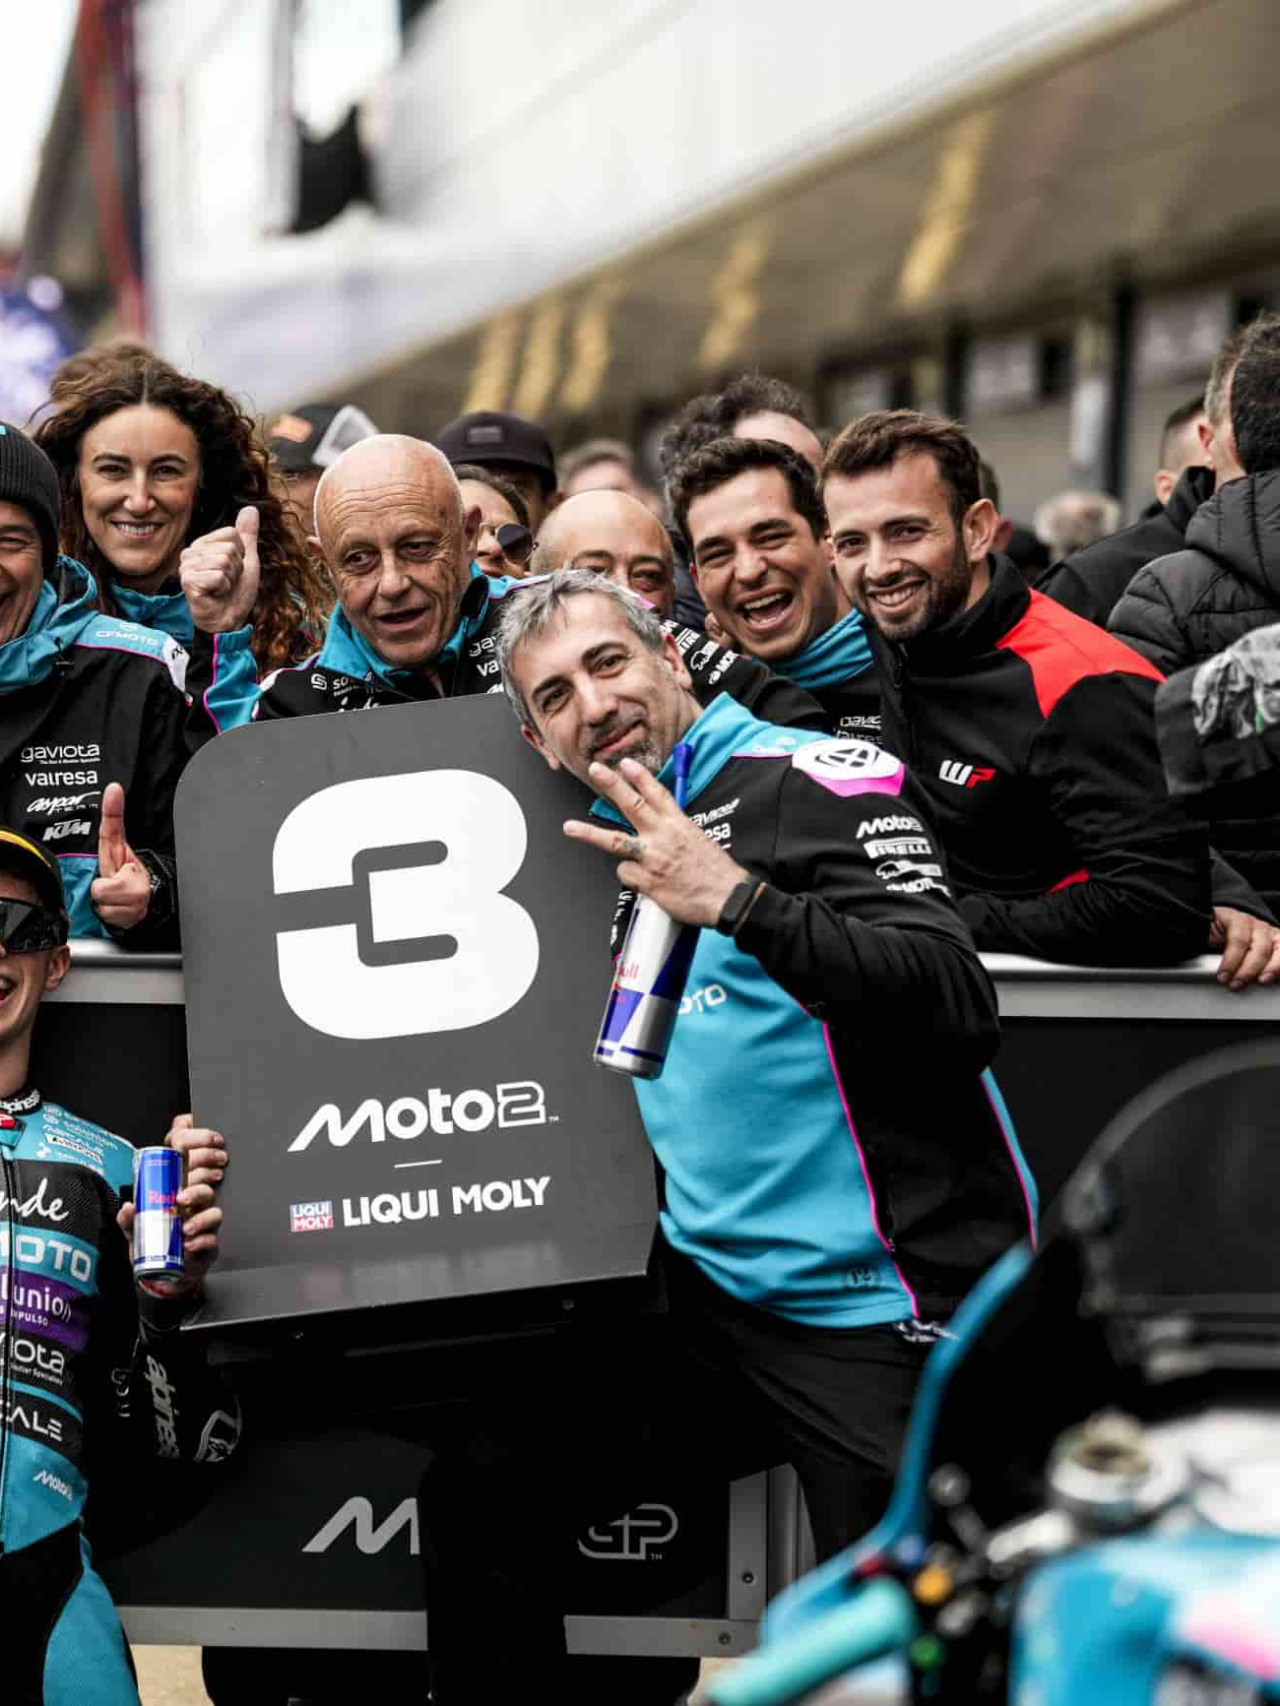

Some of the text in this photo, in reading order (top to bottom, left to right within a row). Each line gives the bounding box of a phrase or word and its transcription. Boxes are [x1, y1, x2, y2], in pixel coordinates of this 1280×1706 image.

[20, 744, 100, 763] gaviota
[939, 760, 997, 788] WP
[43, 819, 91, 841] KTM
[272, 768, 540, 1040] 3
[287, 1081, 546, 1153] Moto2
[292, 1202, 332, 1219] LIQUI
[342, 1176, 552, 1228] LIQUI MOLY
[293, 1214, 333, 1231] MOLY
